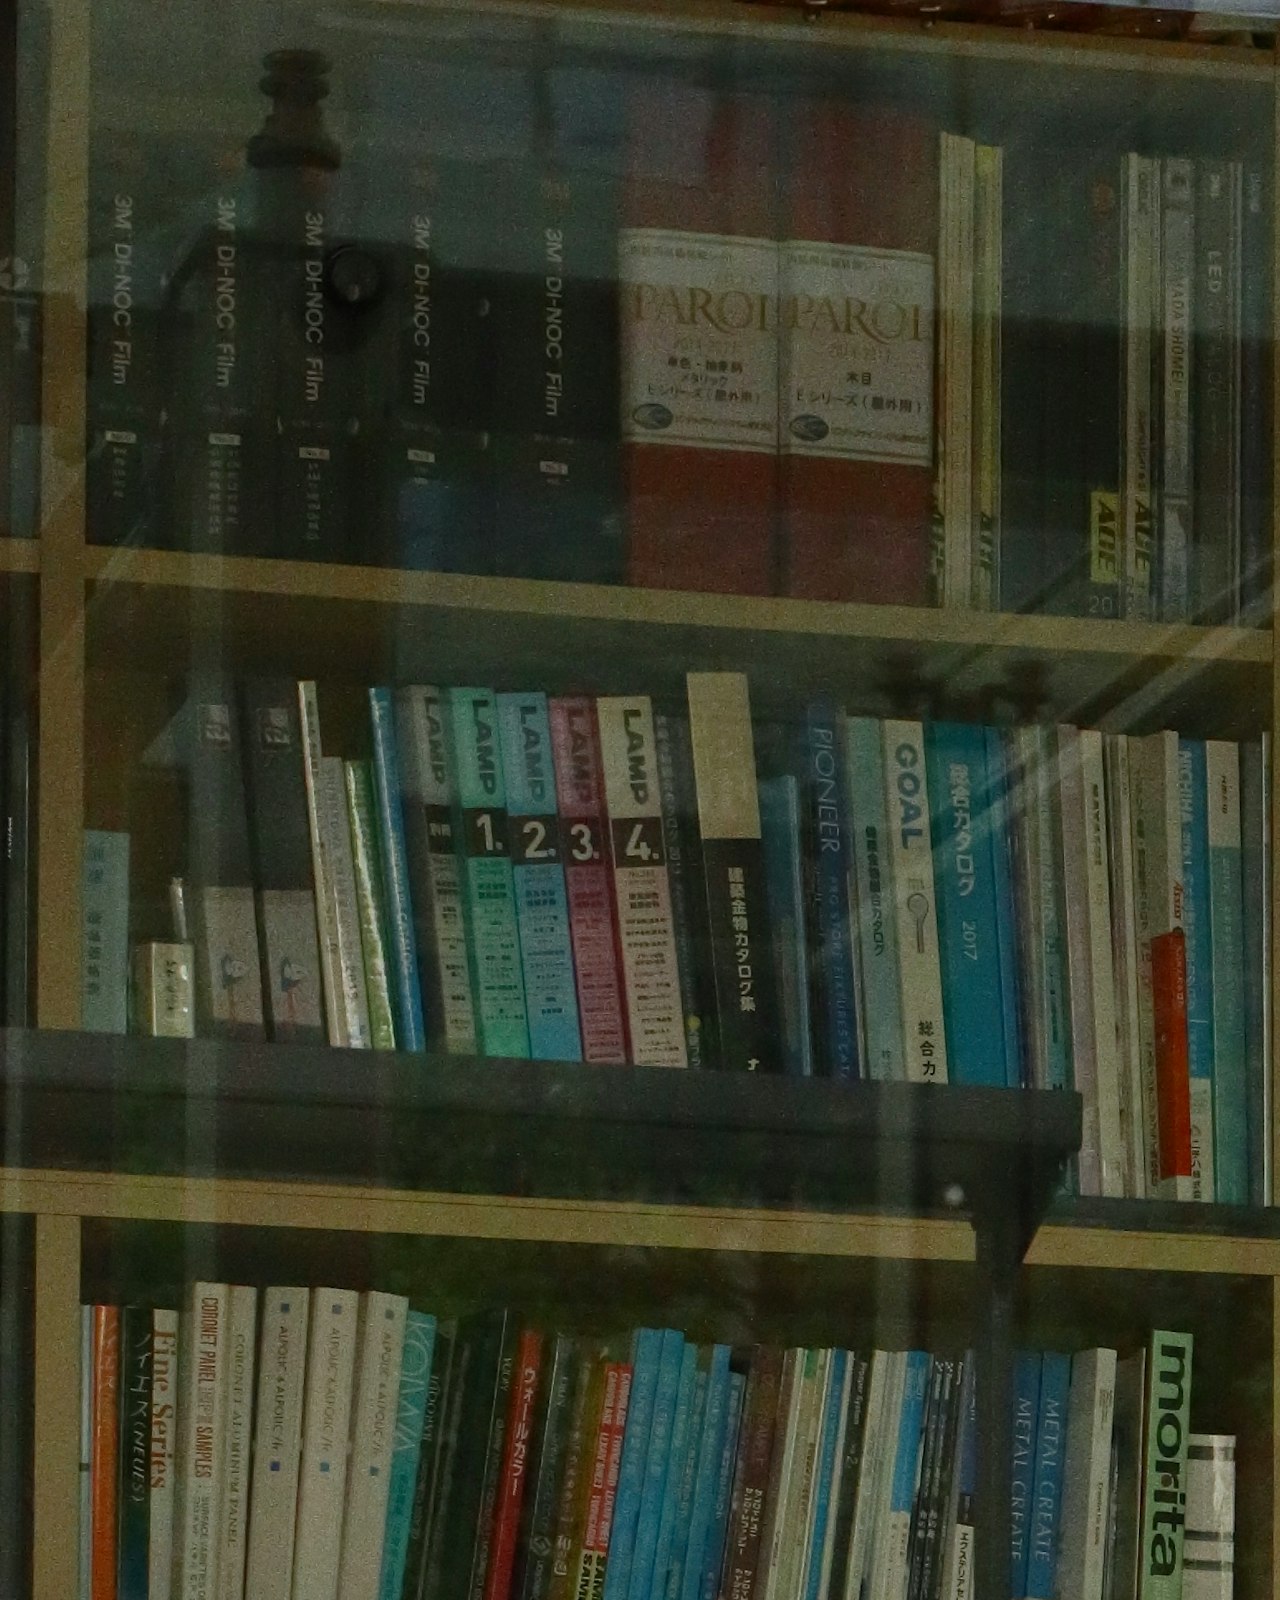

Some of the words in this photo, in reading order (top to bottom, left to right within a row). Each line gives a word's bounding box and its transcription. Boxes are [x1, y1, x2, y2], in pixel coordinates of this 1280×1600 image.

[112, 195, 133, 232] 3M
[216, 198, 235, 233] 3M
[304, 212, 324, 248] 3M
[413, 215, 431, 250] 3M
[546, 228, 564, 262] 3M
[112, 244, 133, 326] DI-NOC
[216, 246, 235, 330] DI-NOC
[304, 261, 324, 343] DI-NOC
[413, 264, 431, 347] DI-NOC
[546, 277, 564, 360] DI-NOC
[112, 340, 133, 385] Film
[216, 342, 235, 388] Film
[304, 357, 324, 402] Film
[413, 361, 431, 405] Film
[546, 373, 564, 418] Film
[471, 696, 497, 796] LAMP
[519, 704, 546, 802] LAMP
[621, 708, 648, 807] LAMP
[813, 726, 840, 853] PIONEER
[894, 741, 924, 849] GOAL
[201, 1297, 219, 1348] CORONET
[198, 1351, 216, 1384] PANEL
[151, 1402, 178, 1490] Series
[194, 1426, 213, 1478] SAMPLES
[1015, 1396, 1032, 1467] METAL
[1044, 1396, 1061, 1464] METAL
[1149, 1342, 1190, 1581] morita
[1034, 1475, 1053, 1562] CREATE
